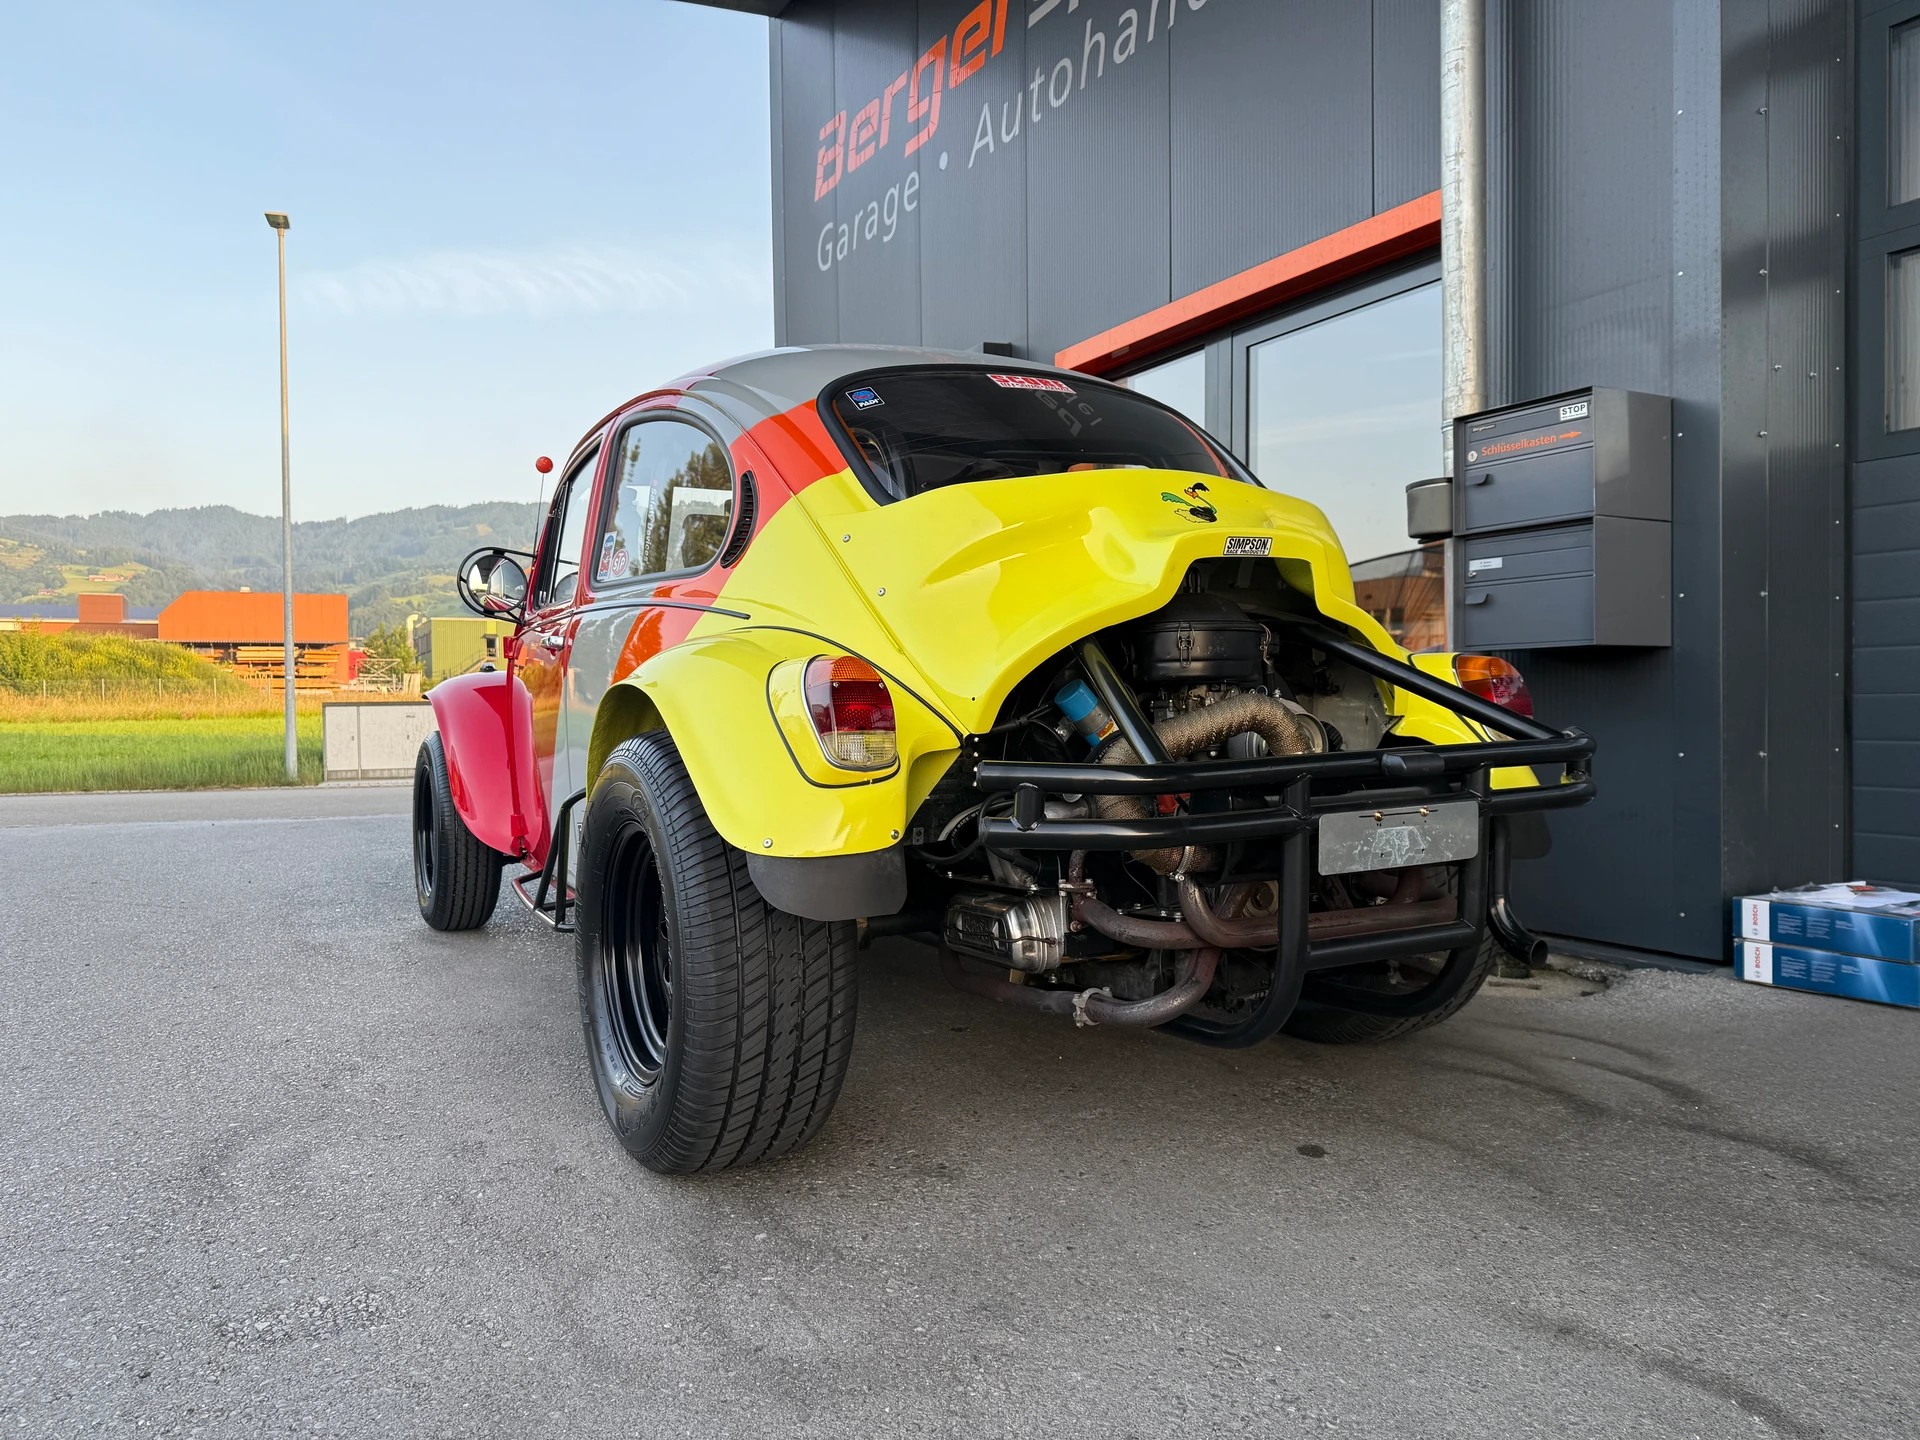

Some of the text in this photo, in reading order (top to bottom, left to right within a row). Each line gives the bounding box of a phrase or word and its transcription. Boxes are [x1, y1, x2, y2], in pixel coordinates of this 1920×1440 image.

[817, 0, 1207, 272] Garage Autohan
[858, 399, 879, 408] PADI
[1561, 404, 1586, 416] STOP
[1481, 435, 1557, 456] Schlüsselkasten
[1227, 538, 1268, 550] SIMPSON
[612, 552, 626, 572] STP
